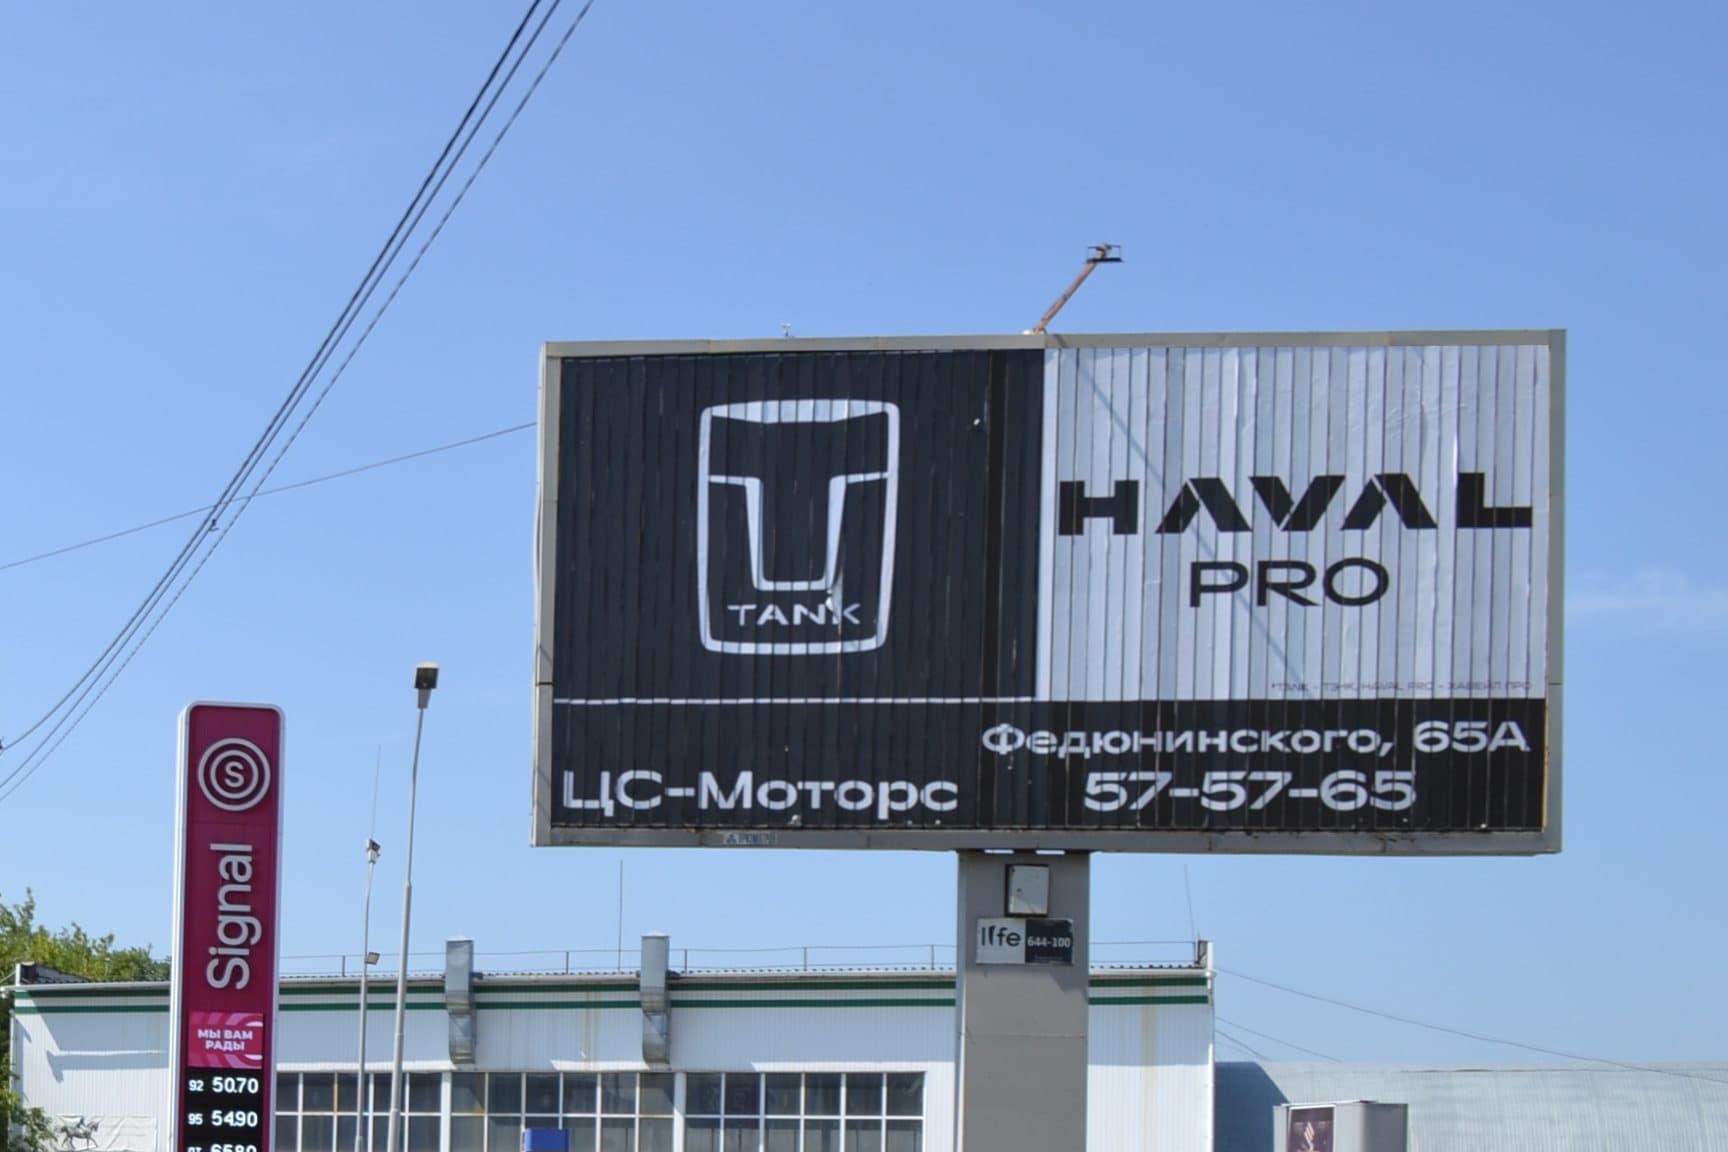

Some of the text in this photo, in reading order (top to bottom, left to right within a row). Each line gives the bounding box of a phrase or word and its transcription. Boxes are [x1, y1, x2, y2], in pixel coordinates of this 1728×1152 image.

[1058, 471, 1533, 535] HAVAL
[1189, 556, 1390, 608] PRO
[728, 603, 862, 626] TANK
[981, 720, 1532, 760] Федюнинского, 65А
[562, 770, 959, 820] ЦС-Моторс
[1083, 770, 1418, 812] 57-57-65
[206, 843, 262, 990] Signal
[1027, 937, 1071, 948] 644-100
[197, 1028, 253, 1040] МЫ ВАМ
[205, 1039, 245, 1051] РАДЫ
[188, 1080, 204, 1092] 92
[187, 1112, 203, 1125] 95
